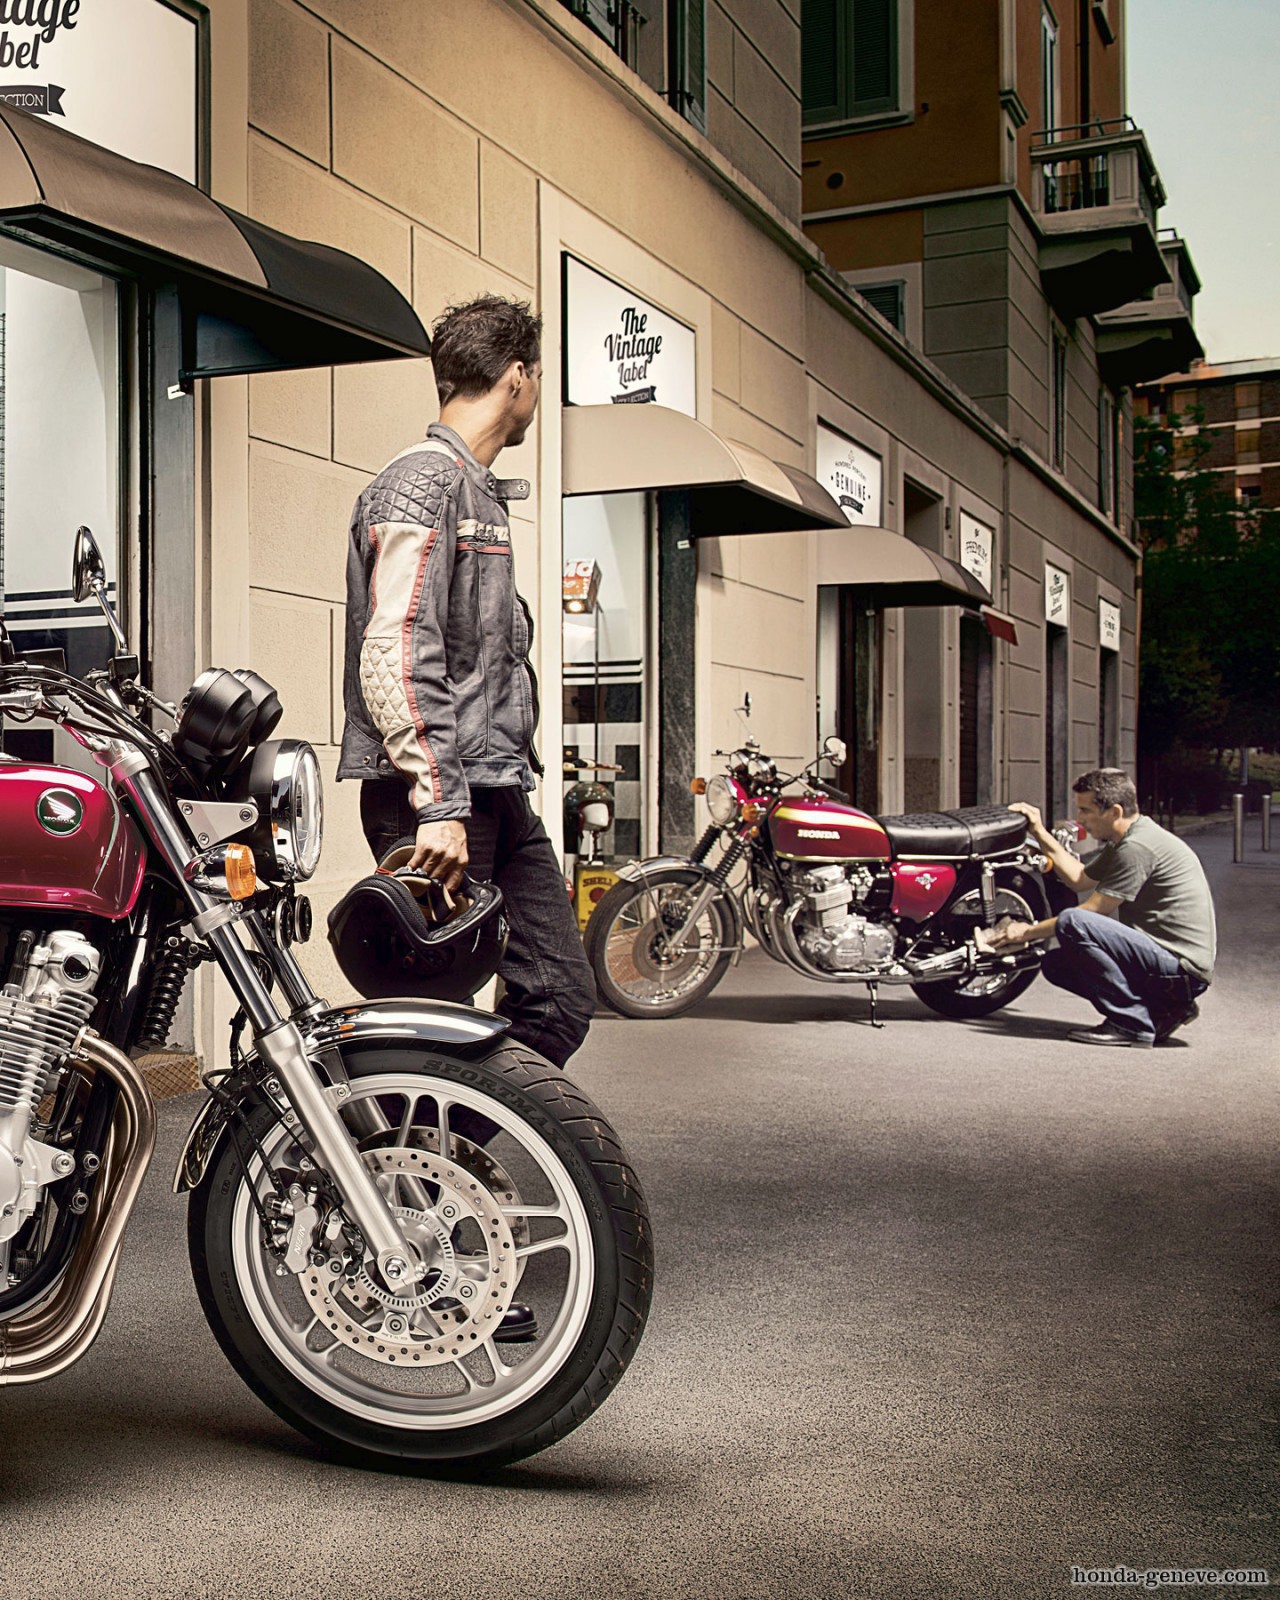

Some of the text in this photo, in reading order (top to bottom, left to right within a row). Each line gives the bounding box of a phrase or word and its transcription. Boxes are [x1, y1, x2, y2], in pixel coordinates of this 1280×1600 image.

[621, 307, 647, 336] The
[604, 333, 663, 364] Vintage
[617, 361, 647, 389] Label
[835, 471, 866, 501] GENUINE
[797, 829, 841, 840] HONDA
[583, 876, 613, 887] SHELL
